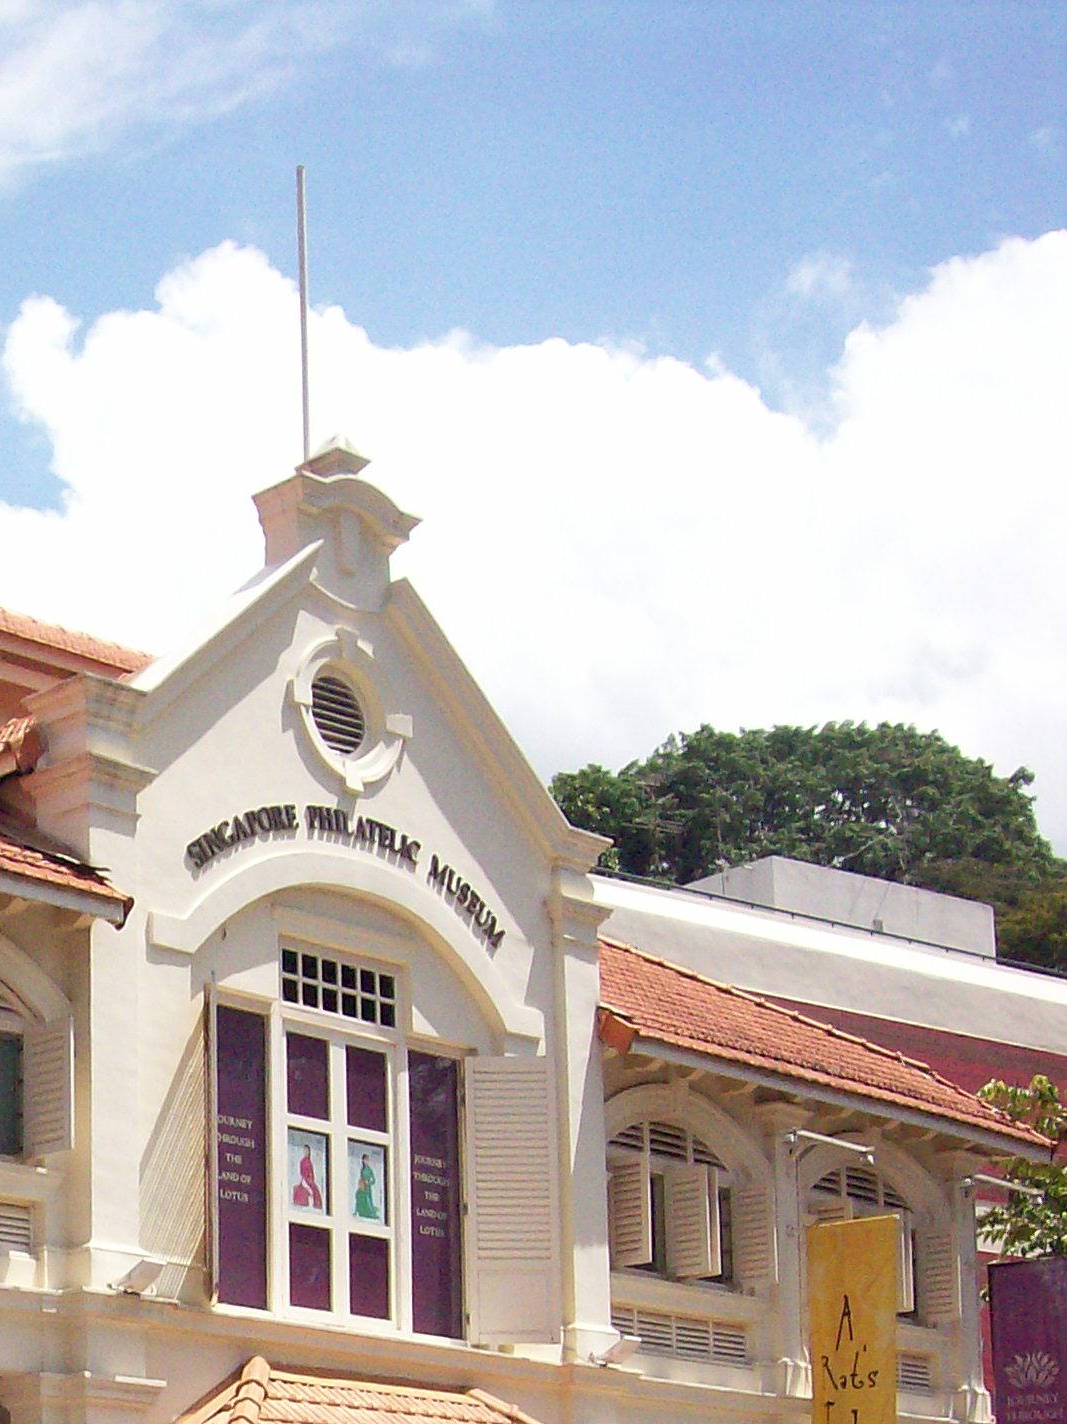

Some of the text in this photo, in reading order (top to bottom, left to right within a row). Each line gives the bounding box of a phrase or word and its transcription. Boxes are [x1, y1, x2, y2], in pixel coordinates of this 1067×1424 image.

[186, 804, 506, 947] SINGAPORE PHILATELIC MUSEUM
[217, 1115, 253, 1129] OURNEY
[225, 1152, 243, 1165] THE
[220, 1188, 249, 1203] LOTUS
[423, 1190, 440, 1202] THE
[416, 1206, 437, 1219] LAND
[419, 1224, 446, 1239] LOTUS
[835, 1294, 854, 1351] A
[821, 1344, 879, 1392] Rat's
